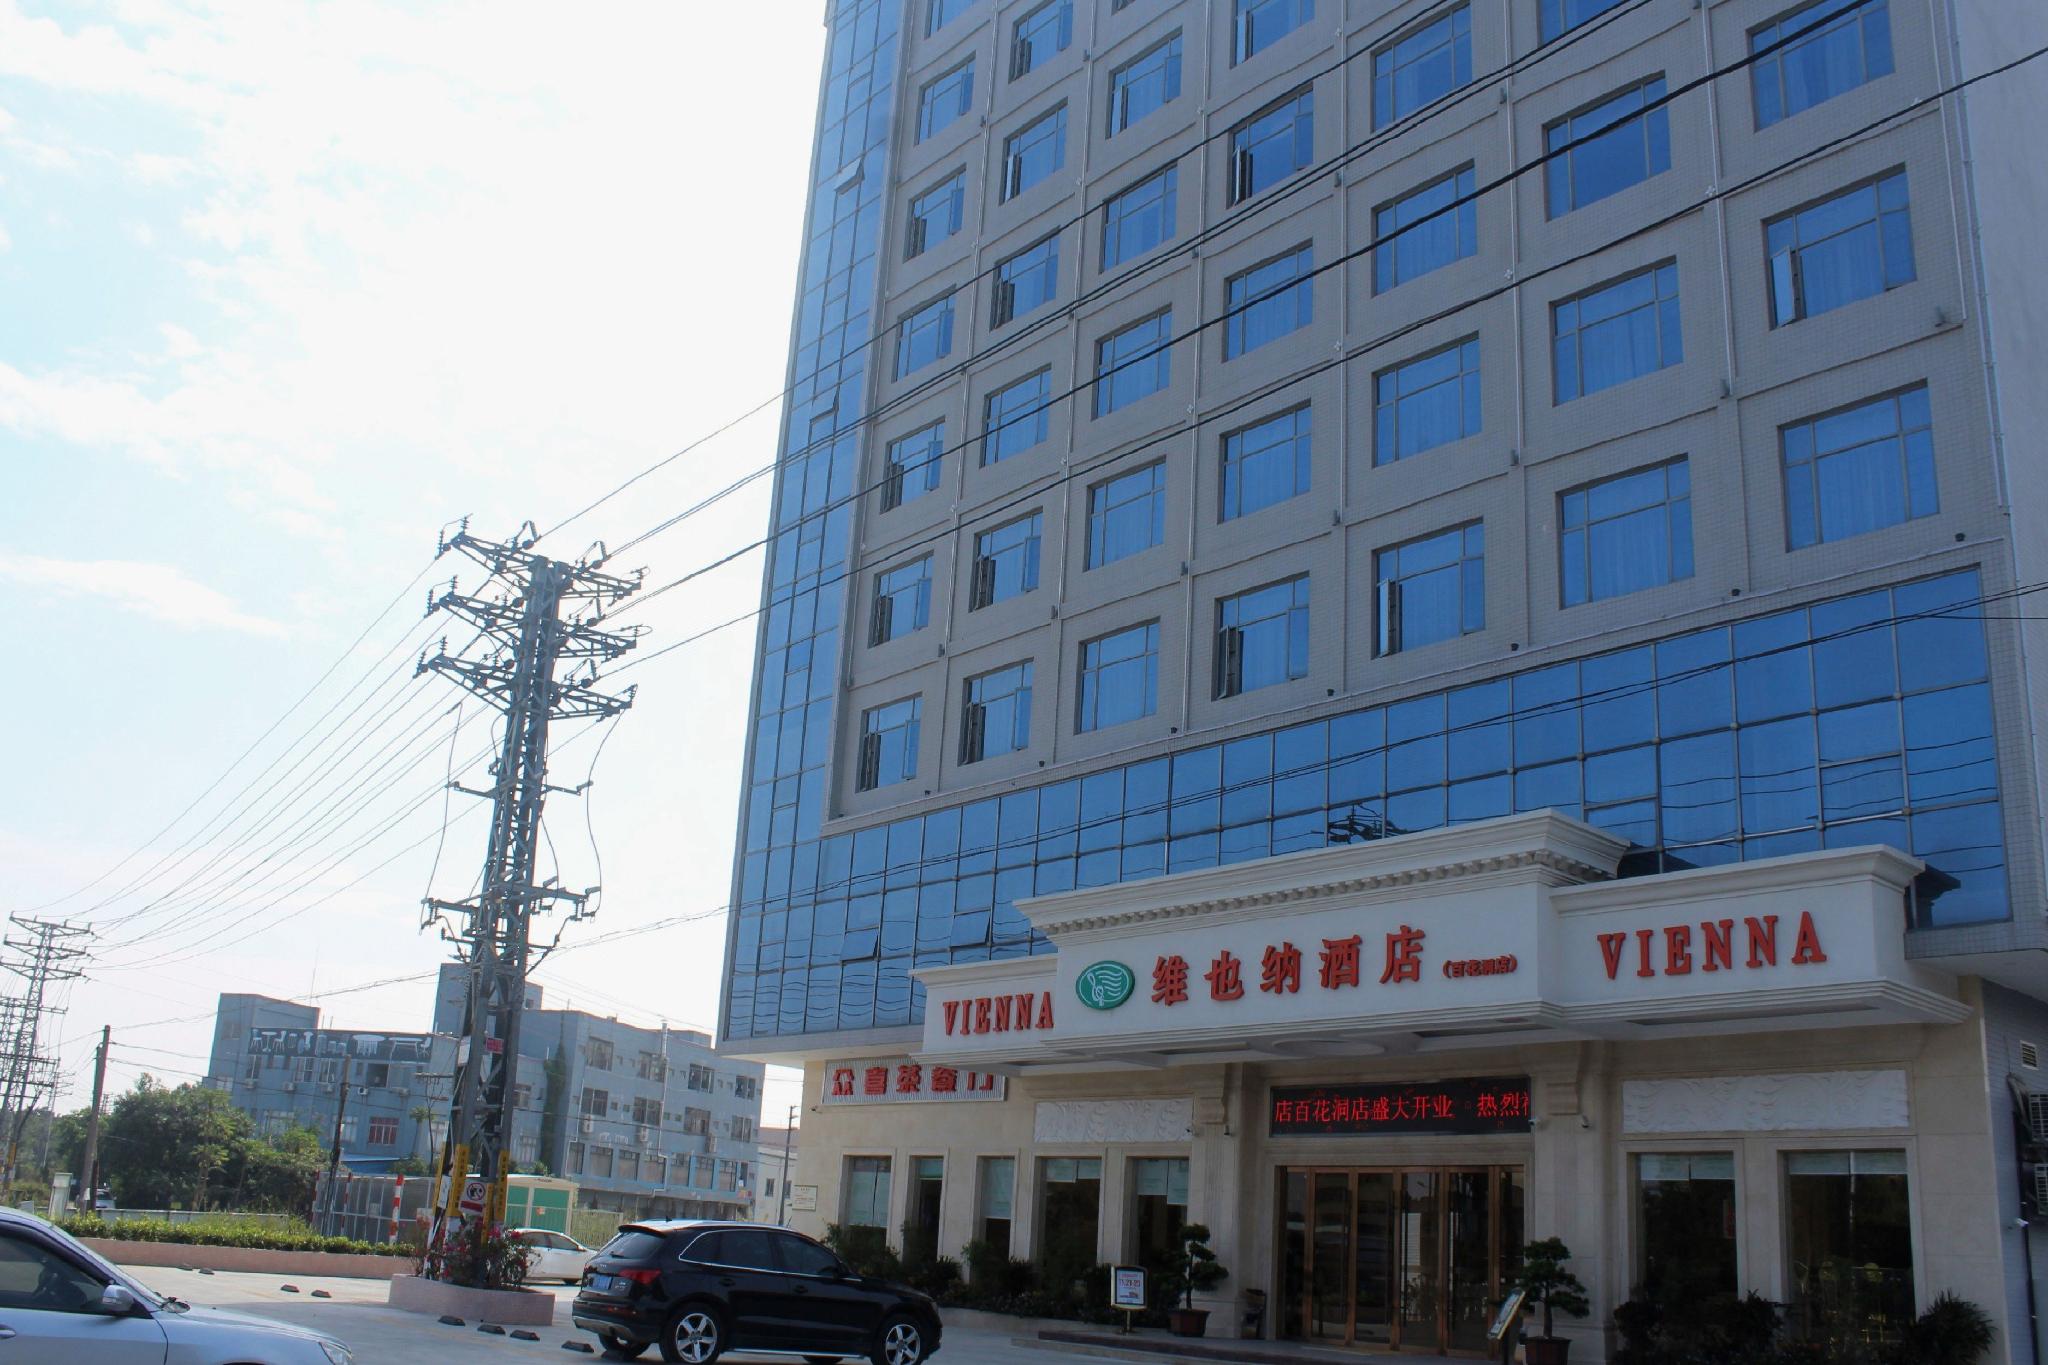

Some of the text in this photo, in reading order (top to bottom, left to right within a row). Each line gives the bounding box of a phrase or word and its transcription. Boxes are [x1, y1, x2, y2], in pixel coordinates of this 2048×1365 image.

[1151, 924, 1426, 1006] 维也纳酒店
[1597, 911, 1827, 980] VIENNA
[942, 991, 1055, 1036] VIENNA
[1275, 1094, 1455, 1122] 店百花洞店盛大开业
